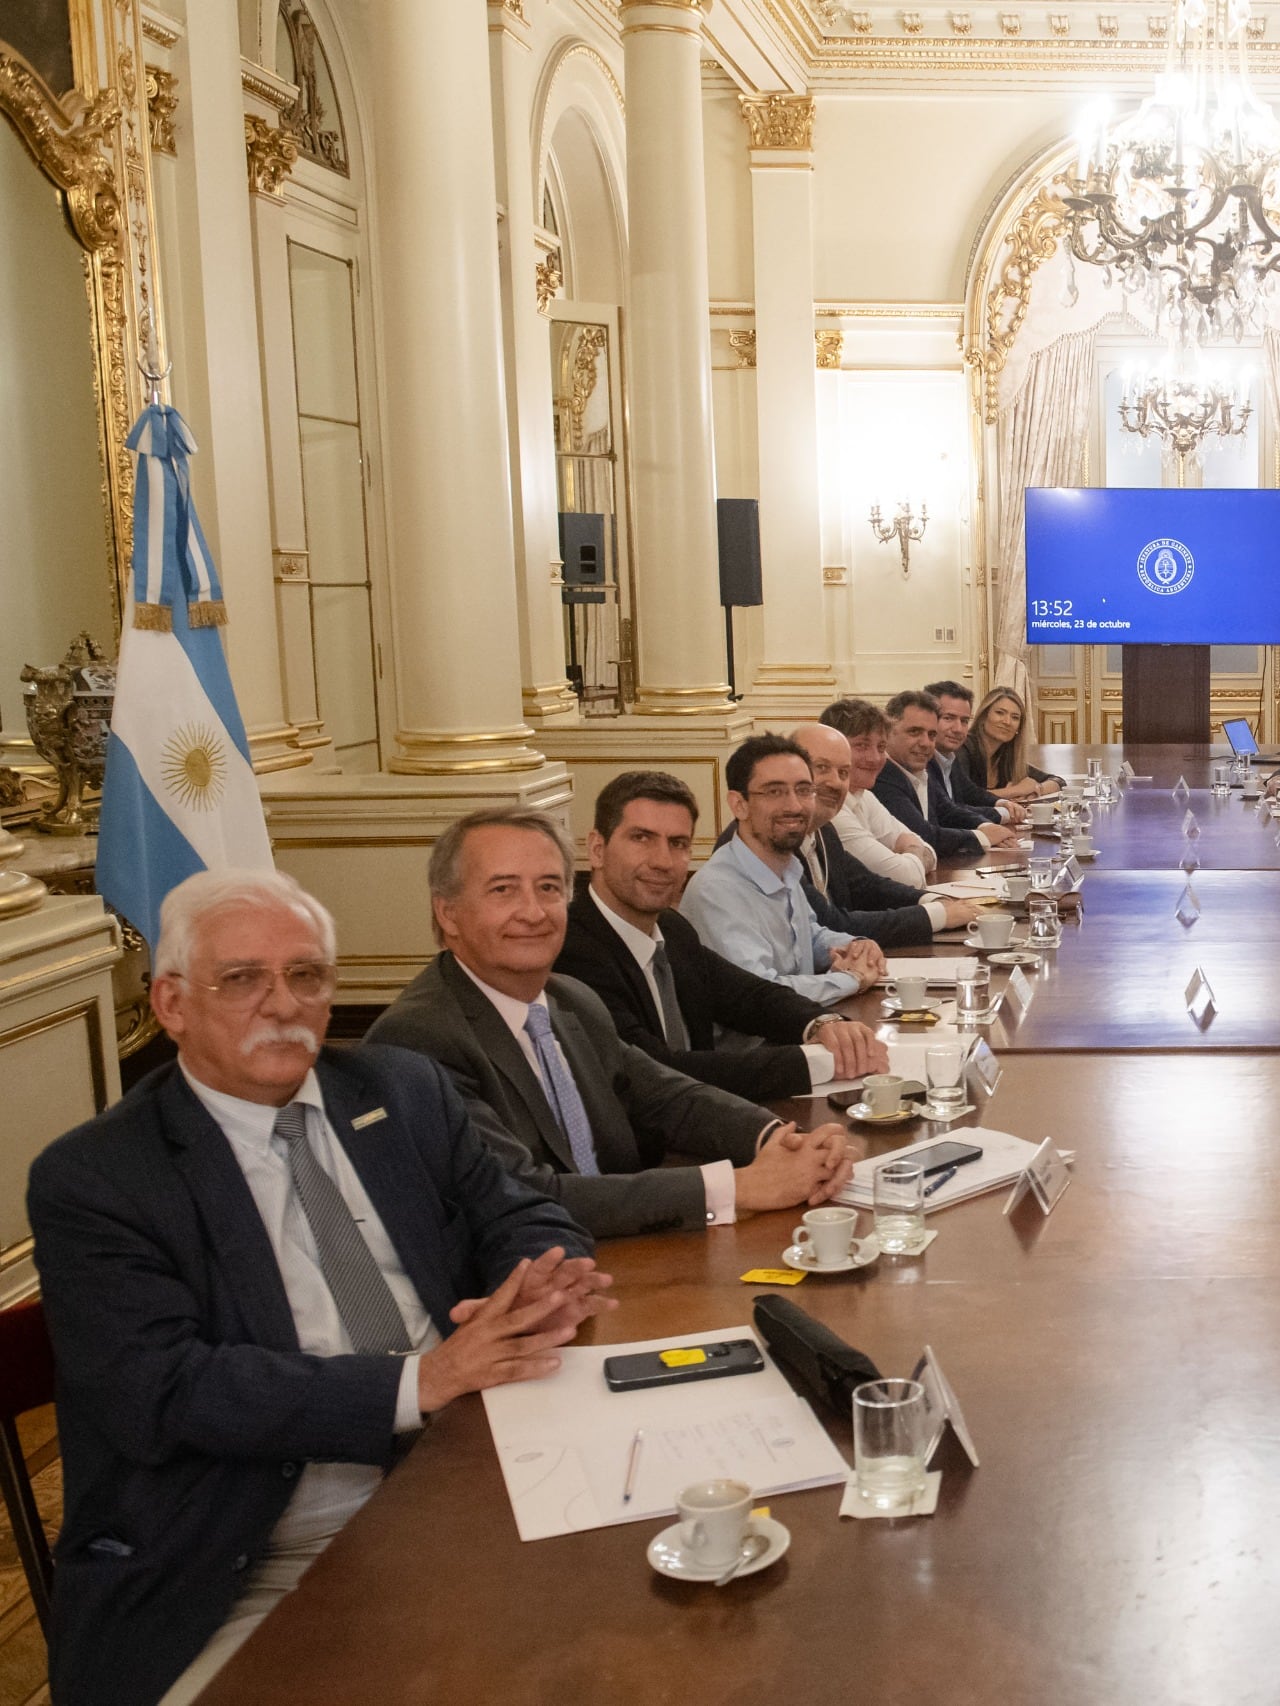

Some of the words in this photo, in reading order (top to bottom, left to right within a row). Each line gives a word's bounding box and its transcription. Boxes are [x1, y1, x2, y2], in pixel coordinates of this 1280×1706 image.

[1031, 600, 1073, 616] 13:52
[1031, 620, 1073, 630] miércoles,
[1074, 620, 1085, 629] 23
[1086, 620, 1098, 629] de
[1099, 620, 1131, 629] octubre
